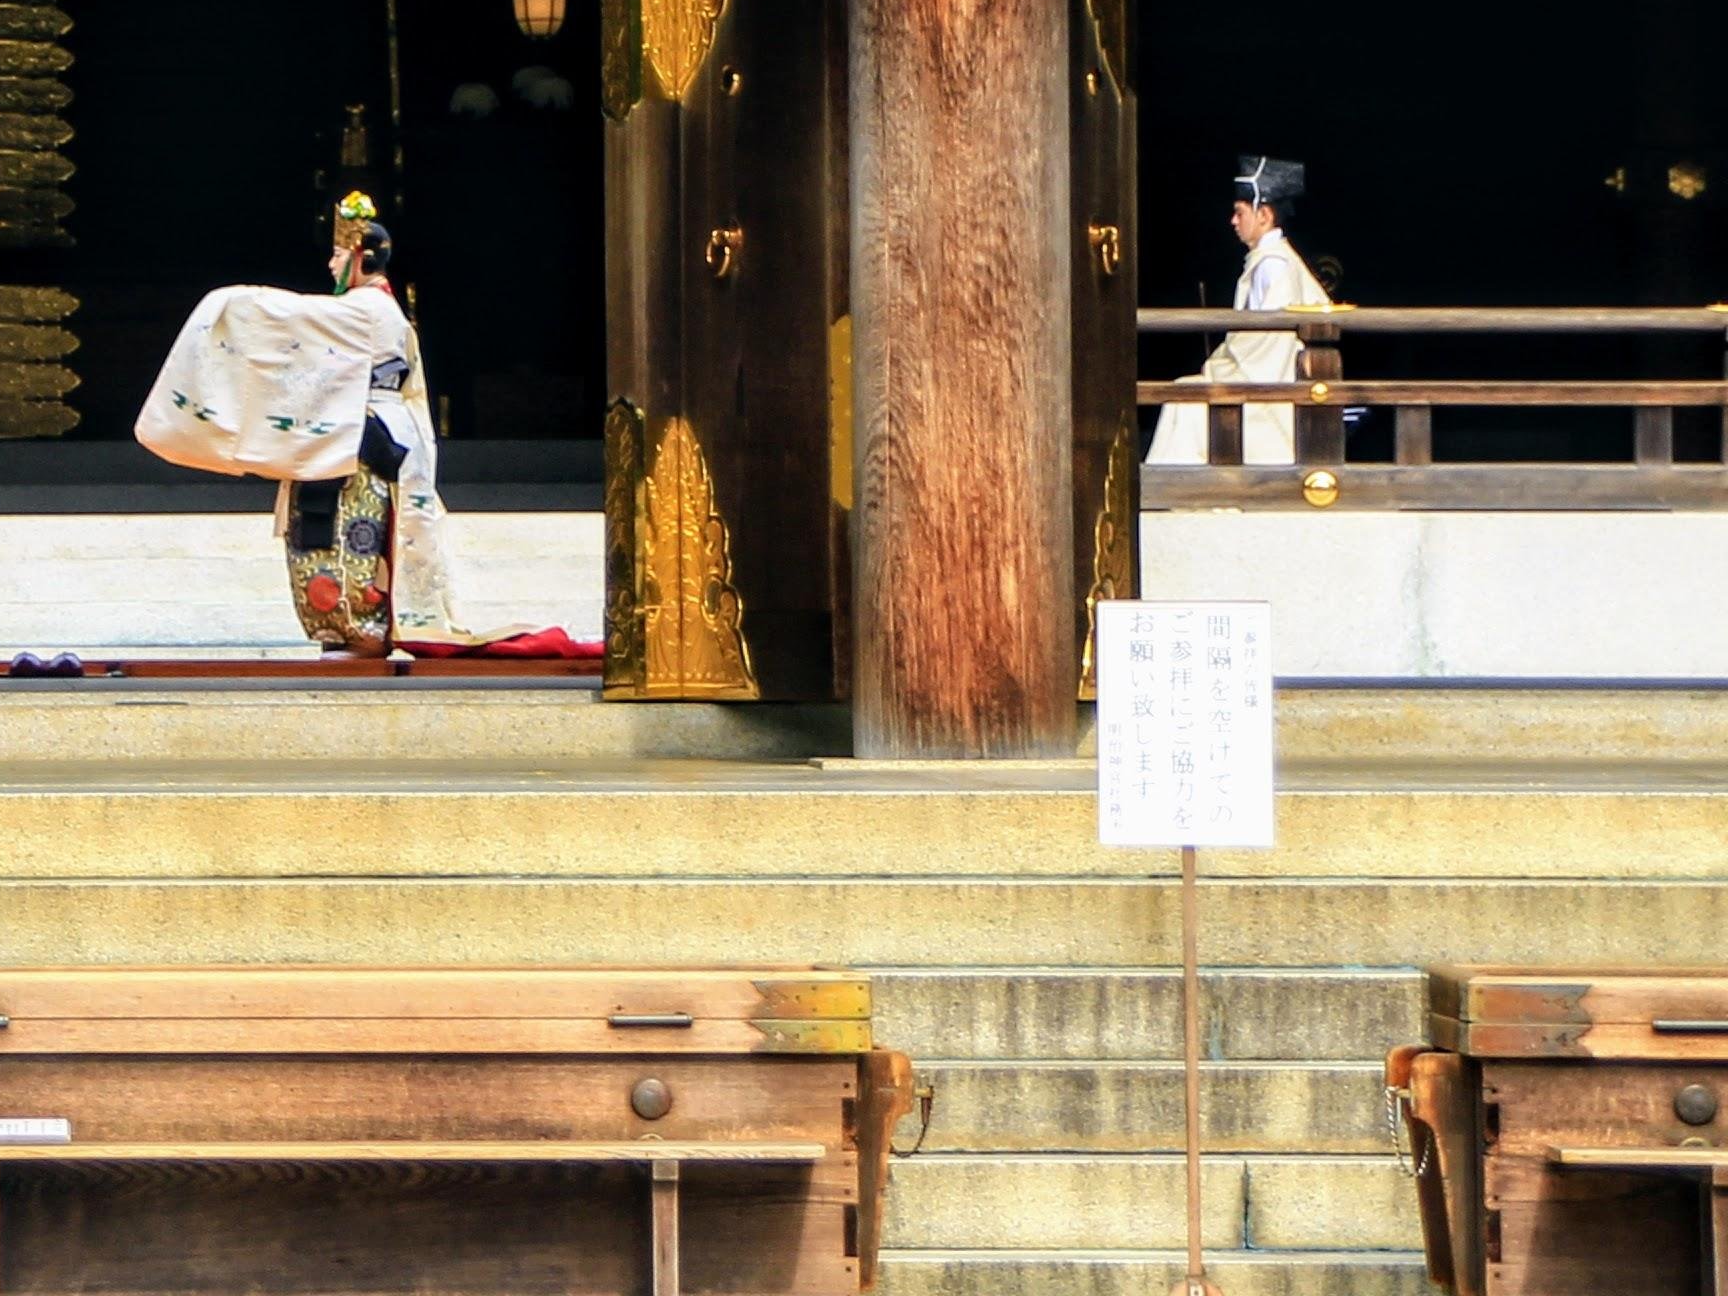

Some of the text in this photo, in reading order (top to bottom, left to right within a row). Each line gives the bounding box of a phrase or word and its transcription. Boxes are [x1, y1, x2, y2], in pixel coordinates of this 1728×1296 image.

[1129, 612, 1154, 798] お願い致します
[1170, 611, 1194, 830] ご参拝にご協力を
[1207, 615, 1232, 822] 間隔を空けての
